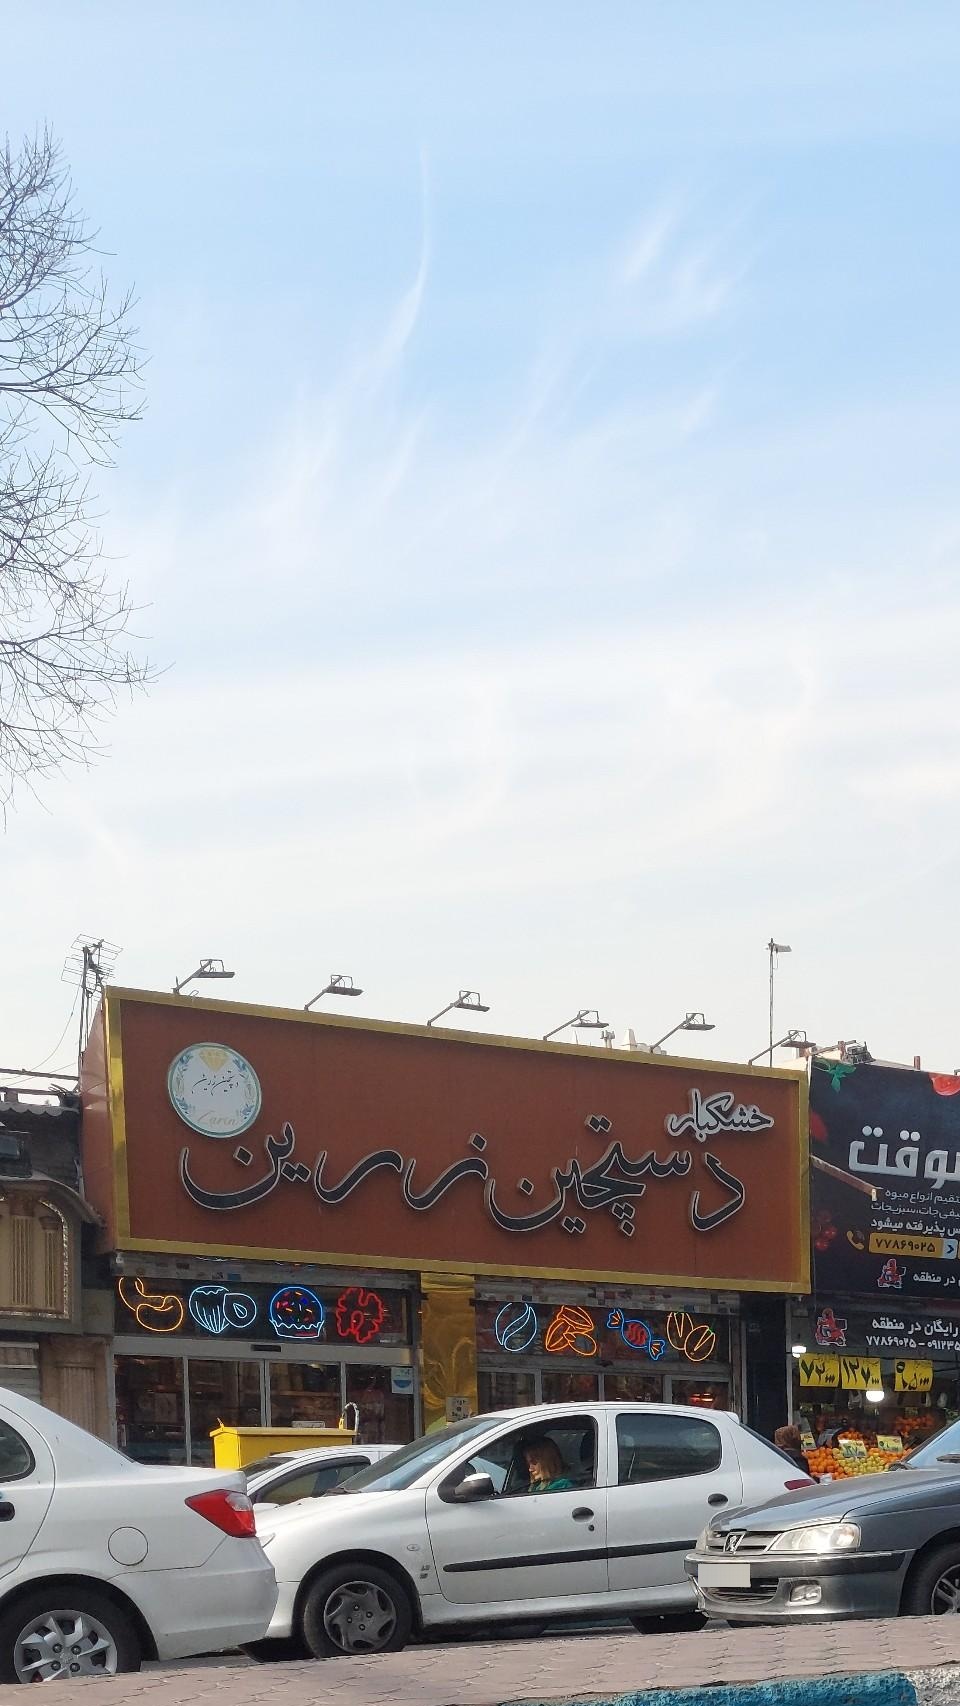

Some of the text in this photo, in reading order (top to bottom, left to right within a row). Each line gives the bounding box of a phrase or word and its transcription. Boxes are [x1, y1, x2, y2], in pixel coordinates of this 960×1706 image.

[666, 1088, 774, 1141] خشکبار
[486, 1114, 745, 1236] دستچین
[885, 1189, 909, 1201] میوه
[909, 1191, 934, 1204] انواع
[871, 1217, 904, 1232] میشود
[913, 1271, 942, 1283] منطقه
[944, 1274, 956, 1287] در
[872, 1317, 905, 1330] منطقه
[908, 1321, 921, 1335] در
[924, 1319, 960, 1337] رایگان
